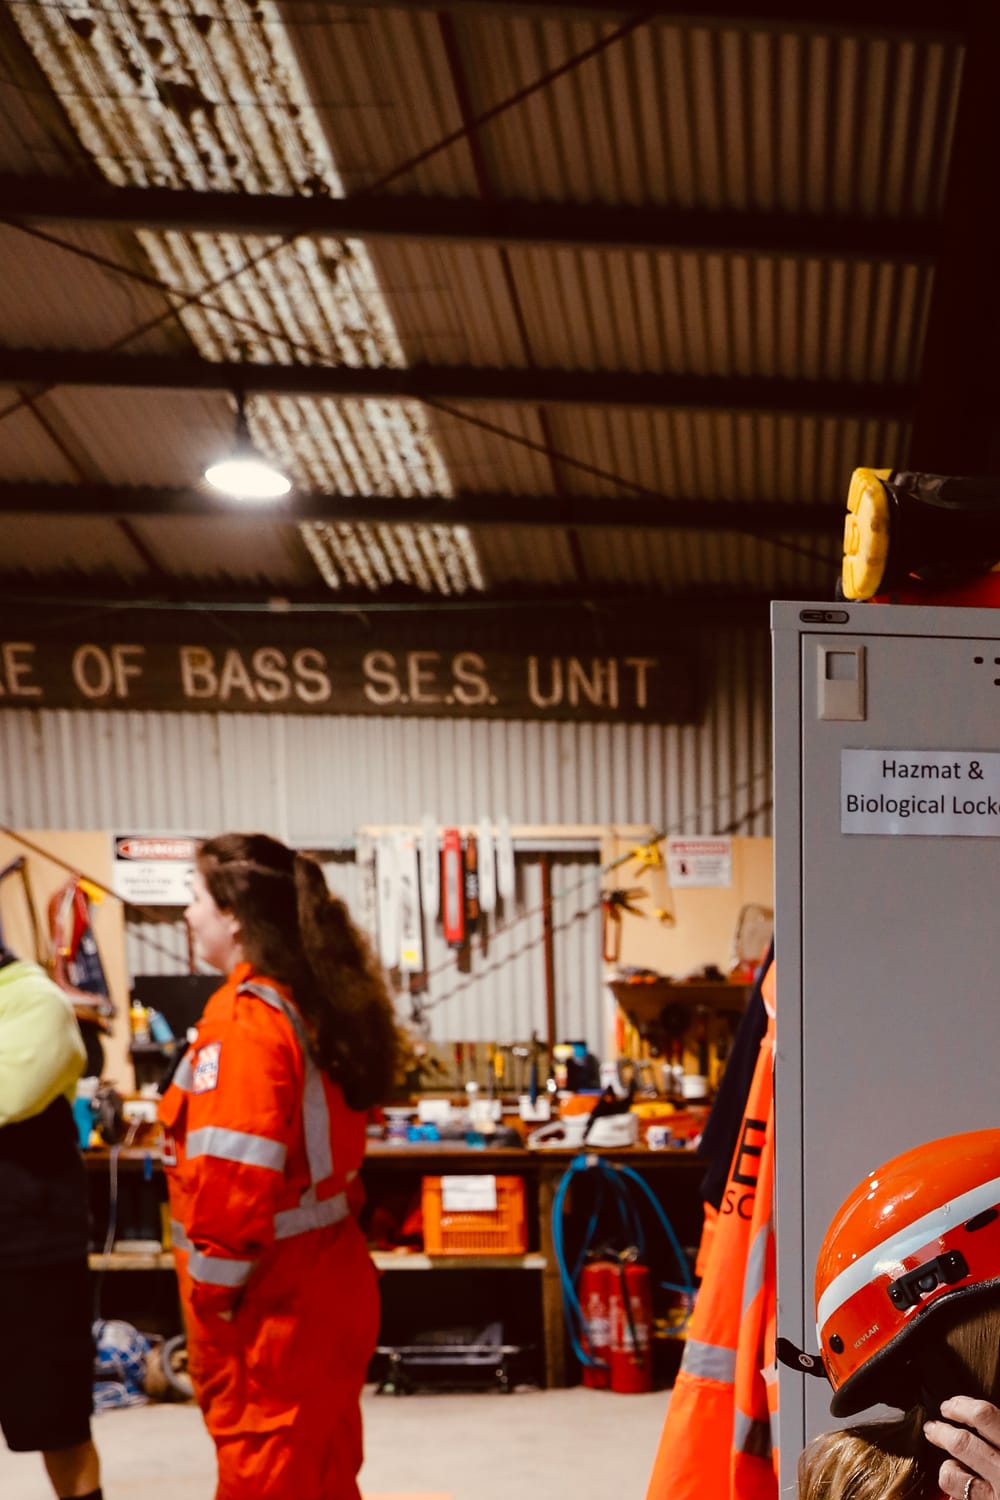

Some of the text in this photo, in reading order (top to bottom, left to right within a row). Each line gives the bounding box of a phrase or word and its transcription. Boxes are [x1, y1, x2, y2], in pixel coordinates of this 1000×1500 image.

[0, 642, 42, 696] E
[71, 643, 145, 698] OF
[178, 645, 332, 702] BASS
[528, 655, 658, 709] UNIT
[882, 759, 984, 780] Hazmat &
[846, 794, 945, 818] Biological
[854, 1323, 880, 1349] KEVLAR
